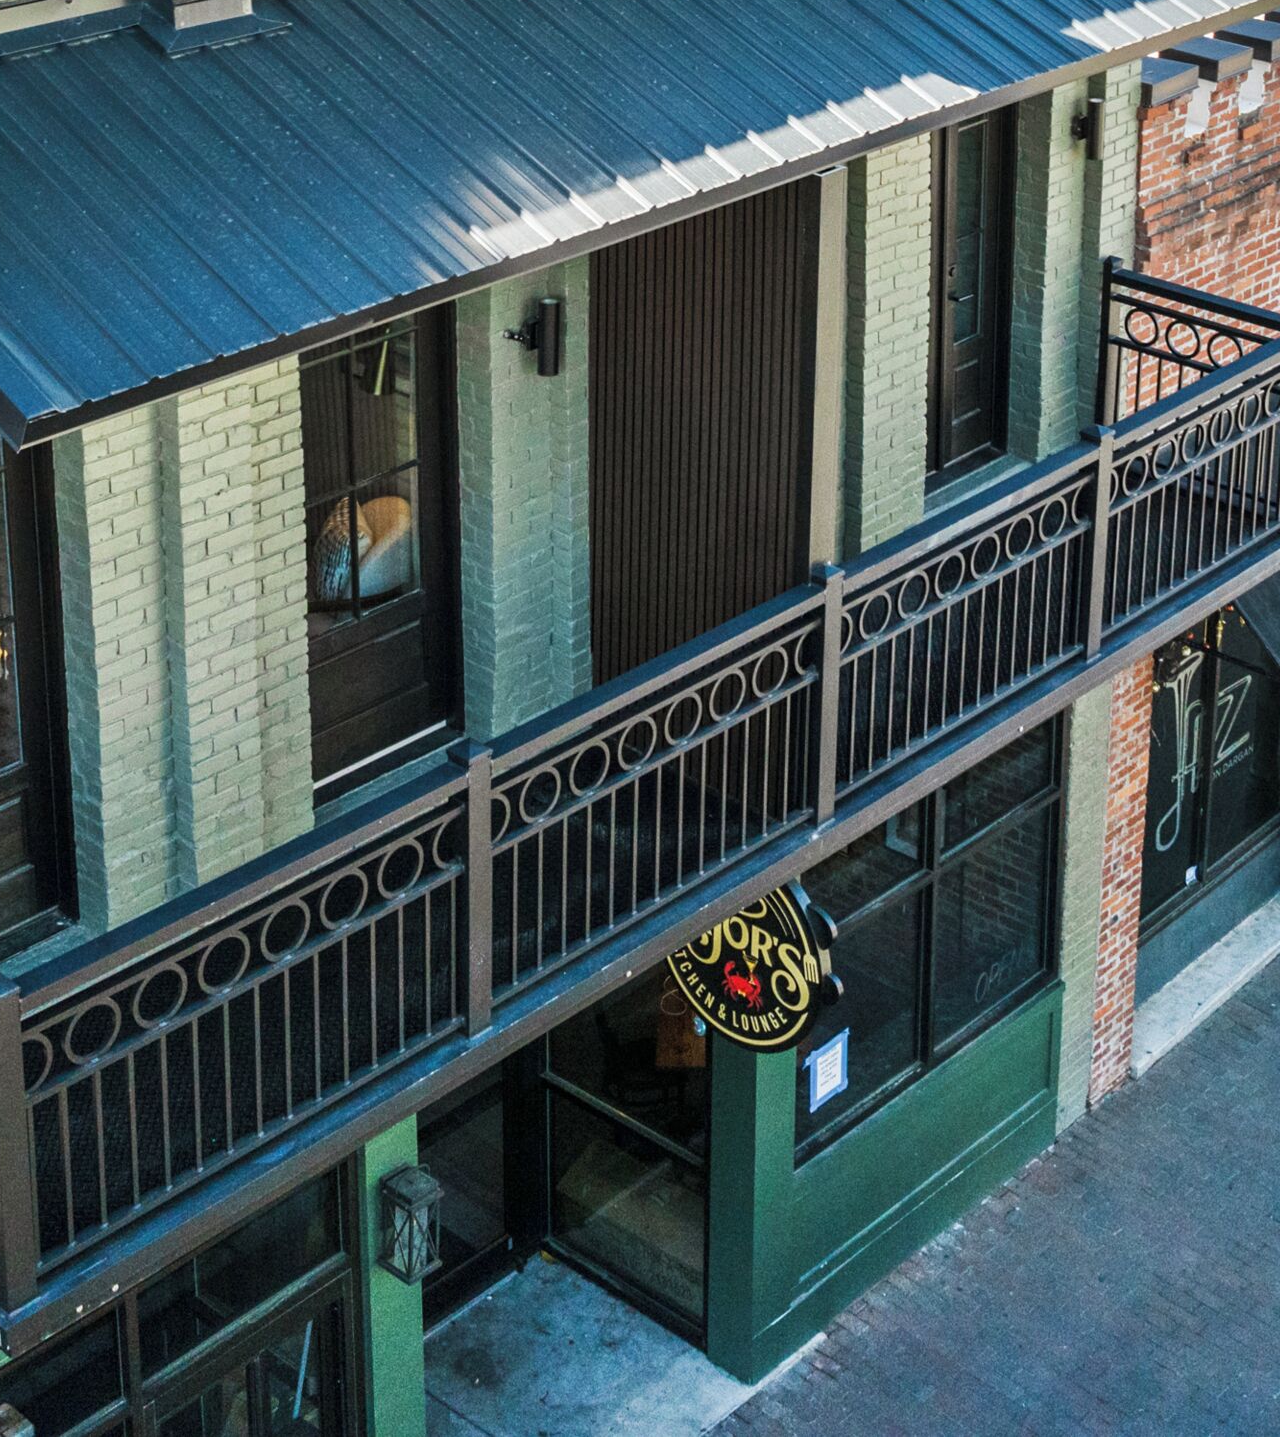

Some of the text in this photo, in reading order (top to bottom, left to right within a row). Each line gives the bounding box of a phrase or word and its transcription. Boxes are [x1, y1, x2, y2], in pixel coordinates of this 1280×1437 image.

[675, 950, 788, 1033] TCHEN & LOUNGE
